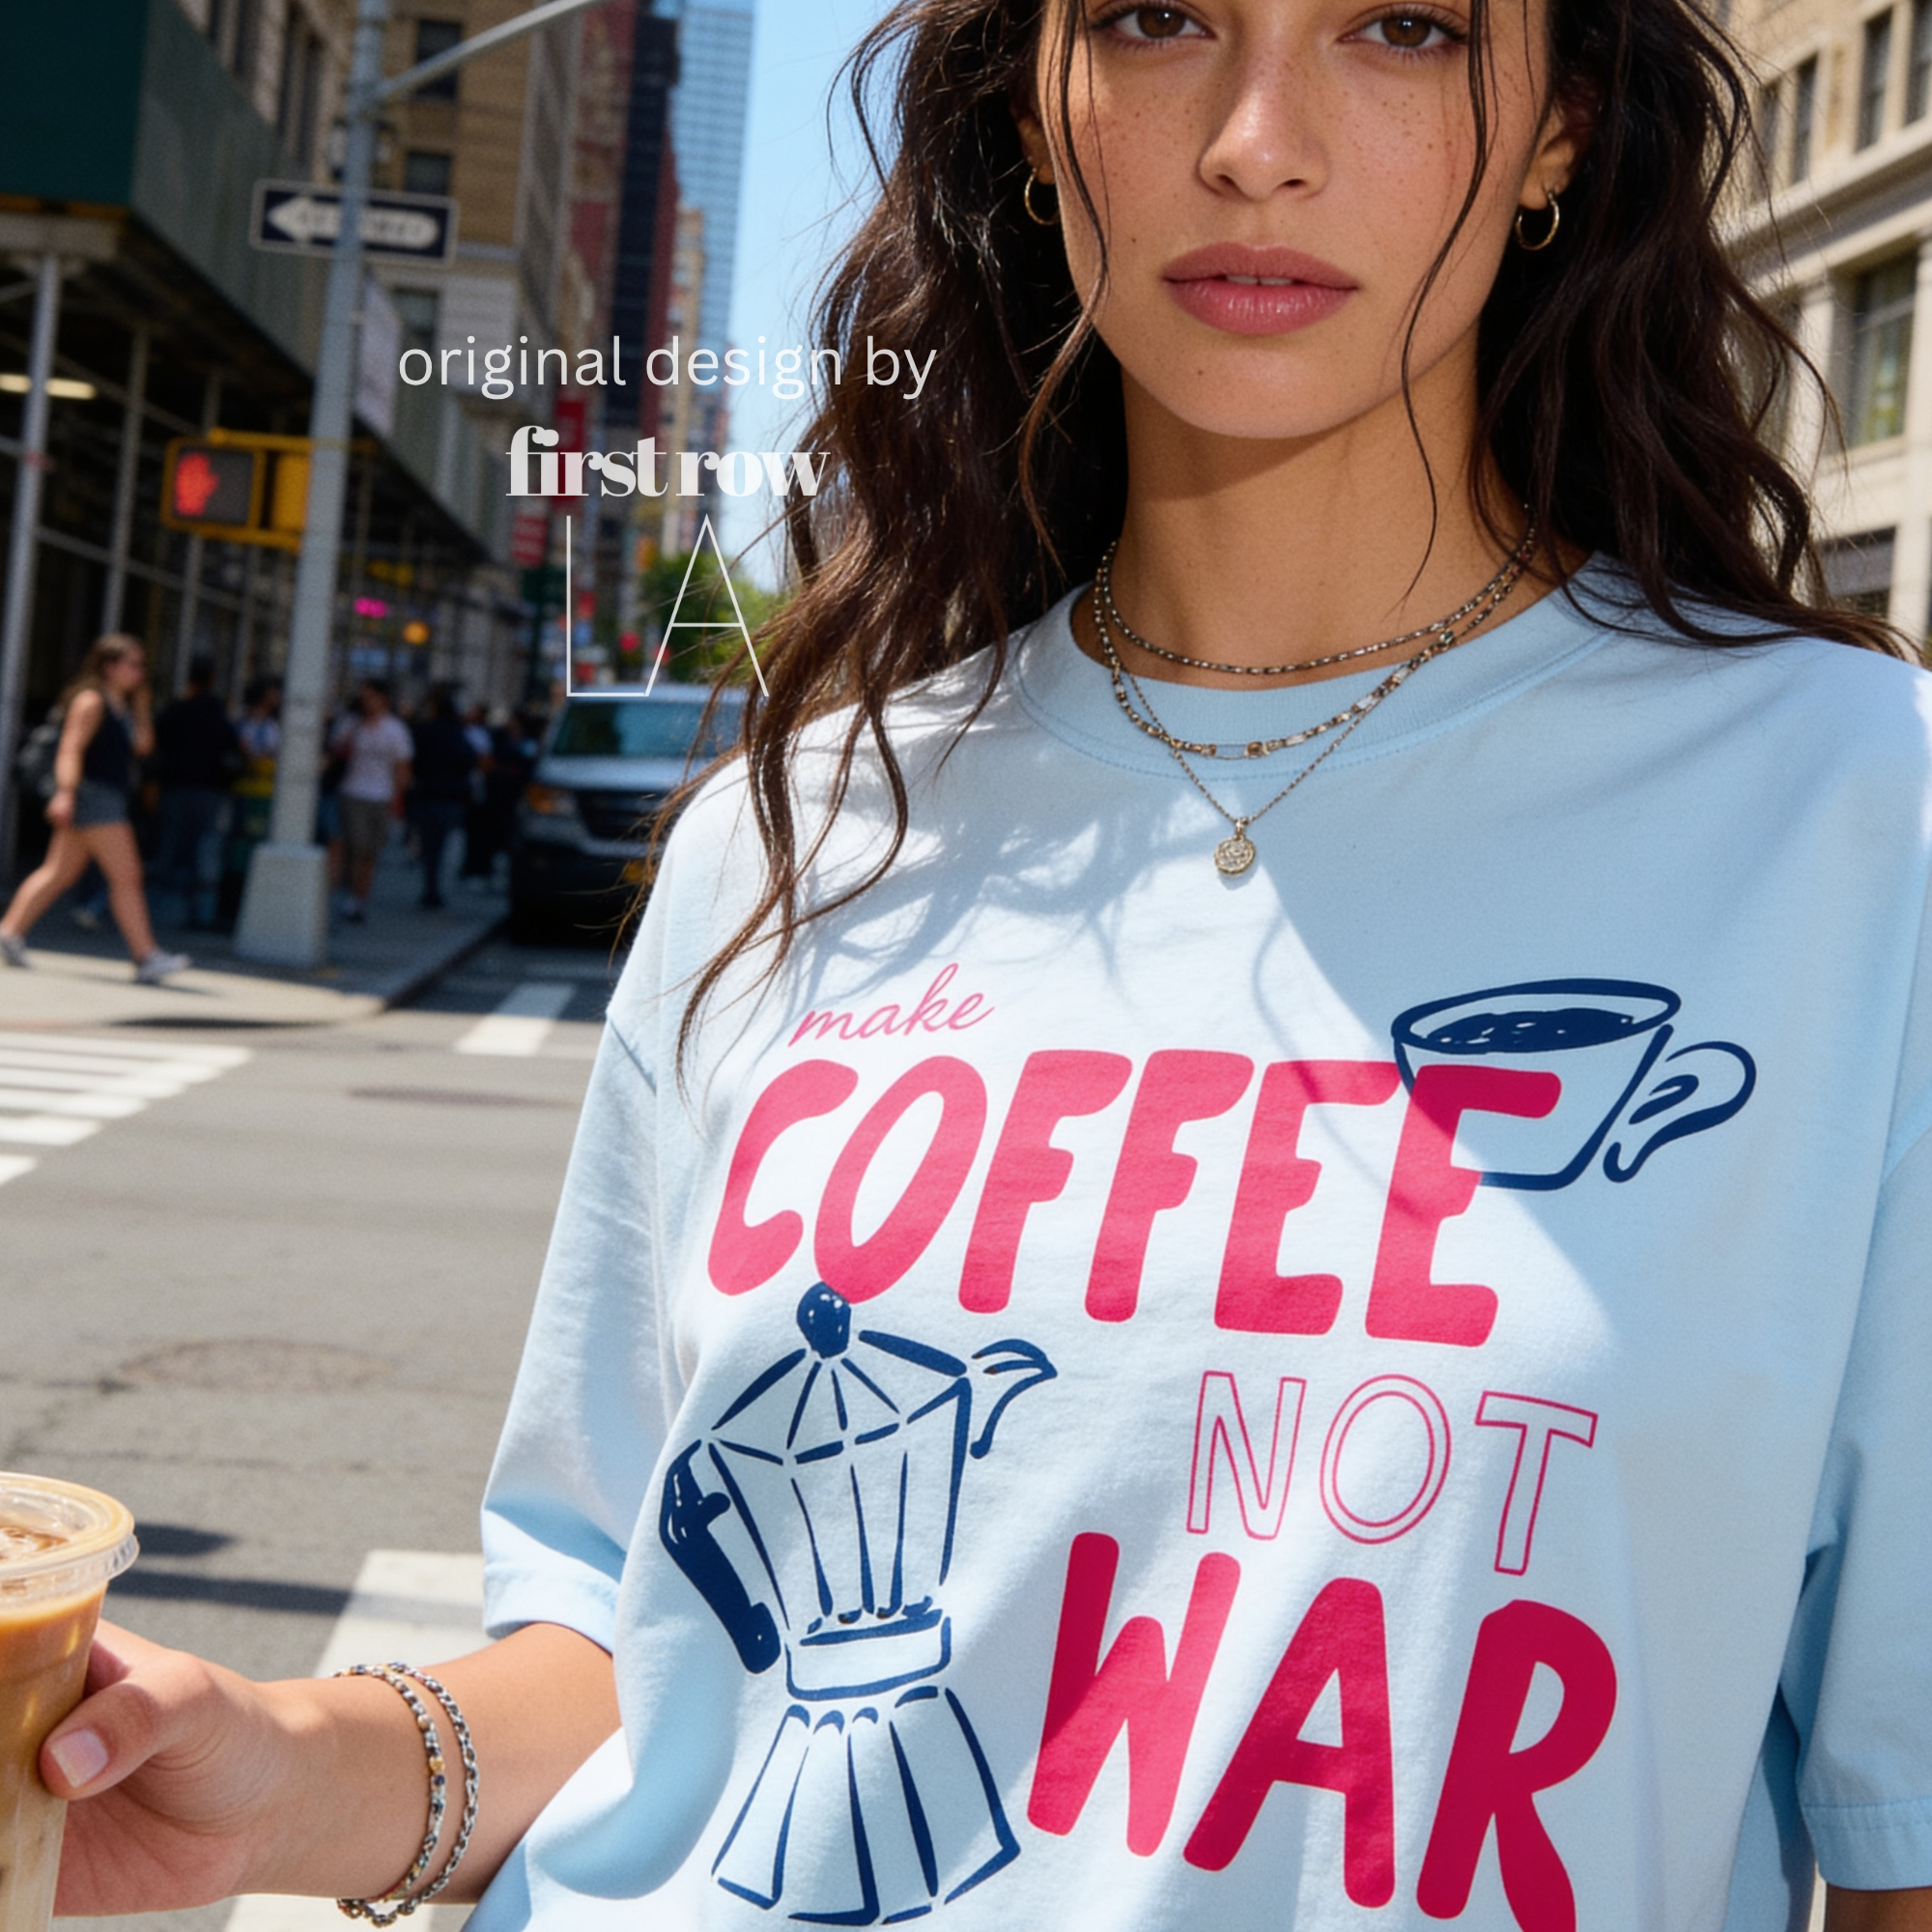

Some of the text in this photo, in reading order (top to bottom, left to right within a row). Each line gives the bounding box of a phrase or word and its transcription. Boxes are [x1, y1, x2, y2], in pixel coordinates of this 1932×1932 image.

[788, 963, 995, 1047] make
[707, 1049, 1562, 1348] COFFEE
[1186, 1371, 1599, 1577] NOT
[1026, 1531, 1618, 1932] WAR
